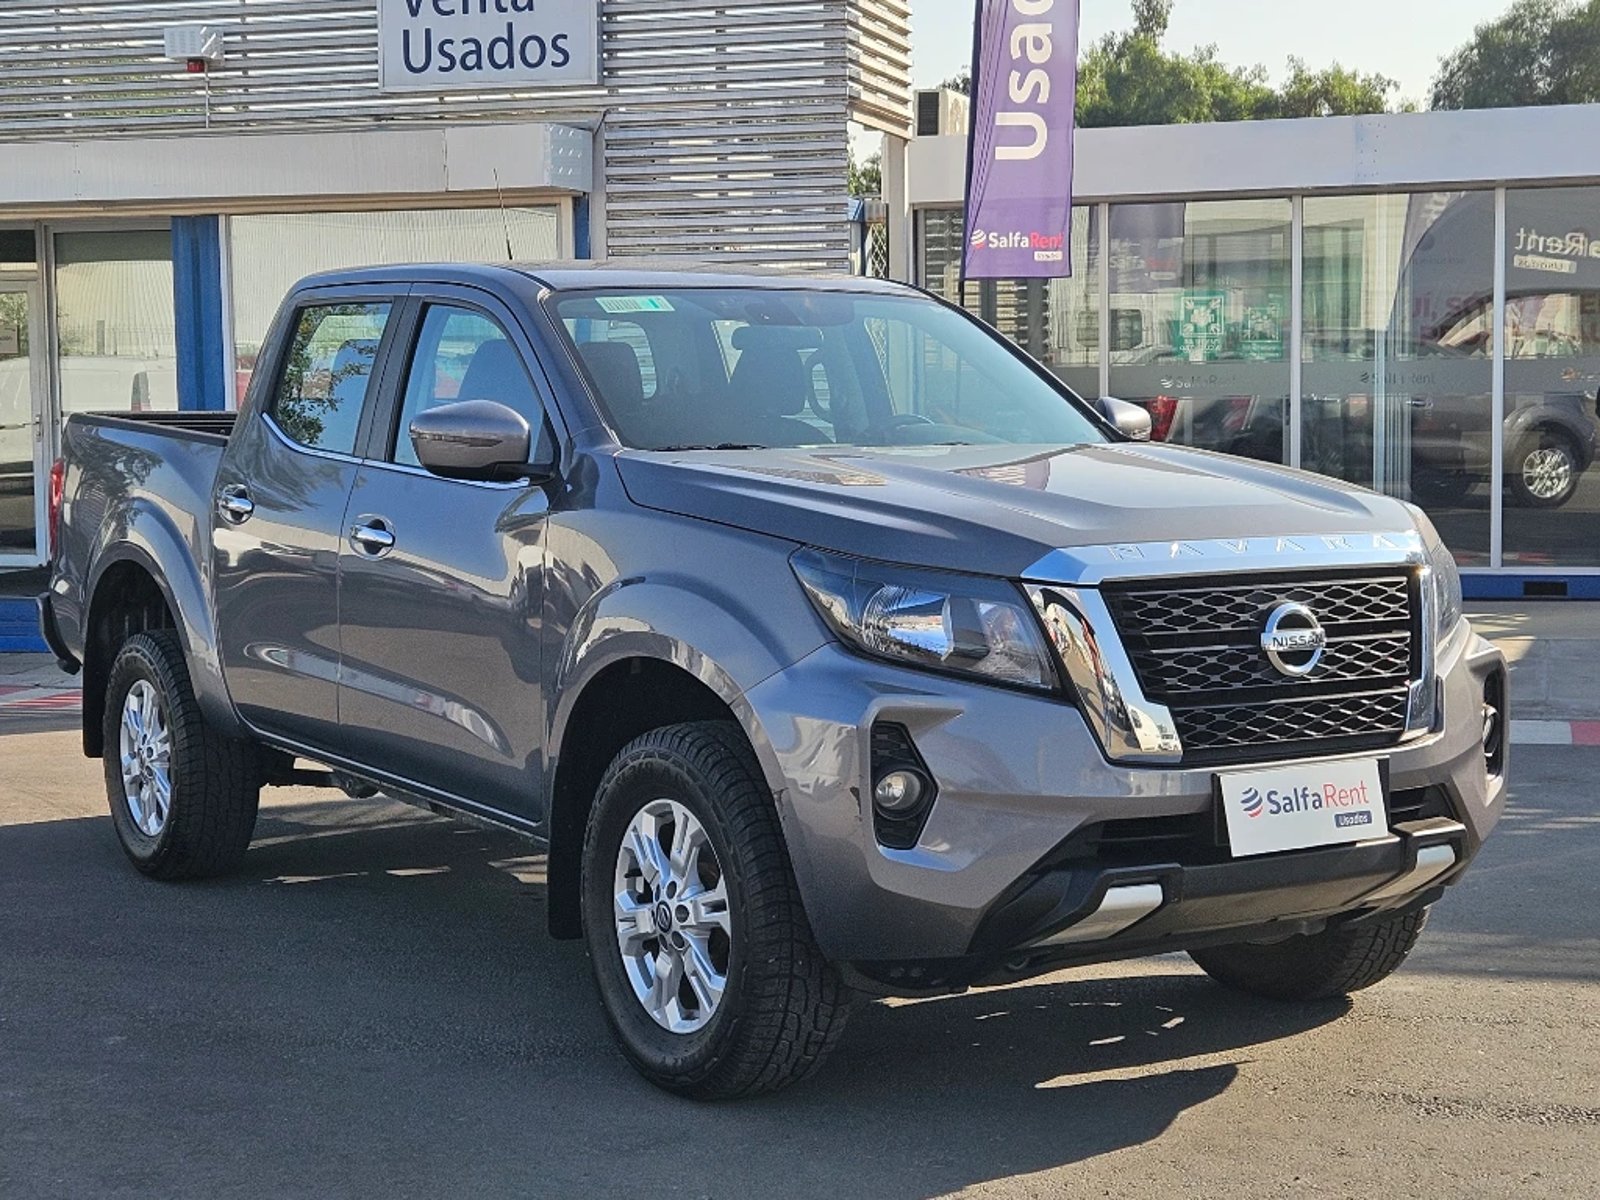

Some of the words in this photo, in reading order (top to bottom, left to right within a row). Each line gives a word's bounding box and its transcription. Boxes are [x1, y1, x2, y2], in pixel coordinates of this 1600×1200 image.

[402, 21, 570, 74] Usados
[988, 231, 1065, 248] SalfaRent
[1107, 533, 1399, 561] NAVARA
[1272, 632, 1323, 648] NISSAN
[1266, 780, 1370, 815] SalfaRent
[1338, 813, 1368, 826] Usados
